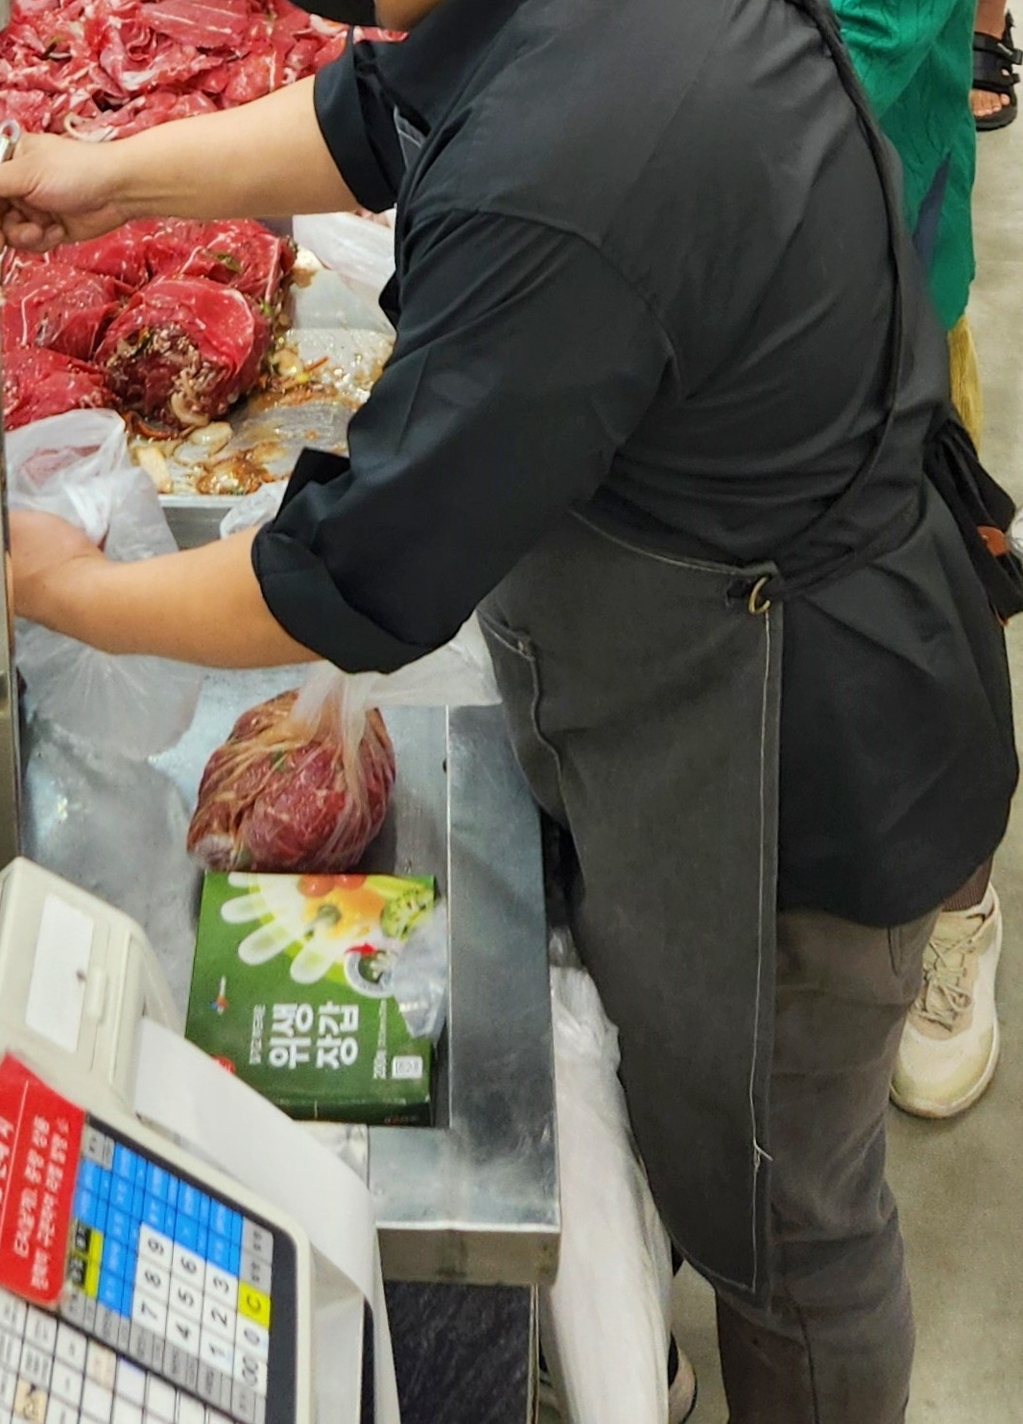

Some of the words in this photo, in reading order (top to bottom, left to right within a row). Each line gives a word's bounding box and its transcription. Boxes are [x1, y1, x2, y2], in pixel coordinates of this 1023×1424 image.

[269, 1003, 314, 1069] 위생
[316, 1000, 359, 1069] 장갑
[147, 1237, 165, 1257] 9
[180, 1256, 198, 1275] 6
[144, 1270, 162, 1289] 8
[212, 1275, 229, 1294] 3
[177, 1289, 194, 1308] 5
[246, 1294, 262, 1314] C
[141, 1301, 159, 1321] 7
[211, 1308, 228, 1327] 2
[176, 1323, 192, 1340] 4
[243, 1329, 261, 1347] 0
[208, 1341, 226, 1358] 1
